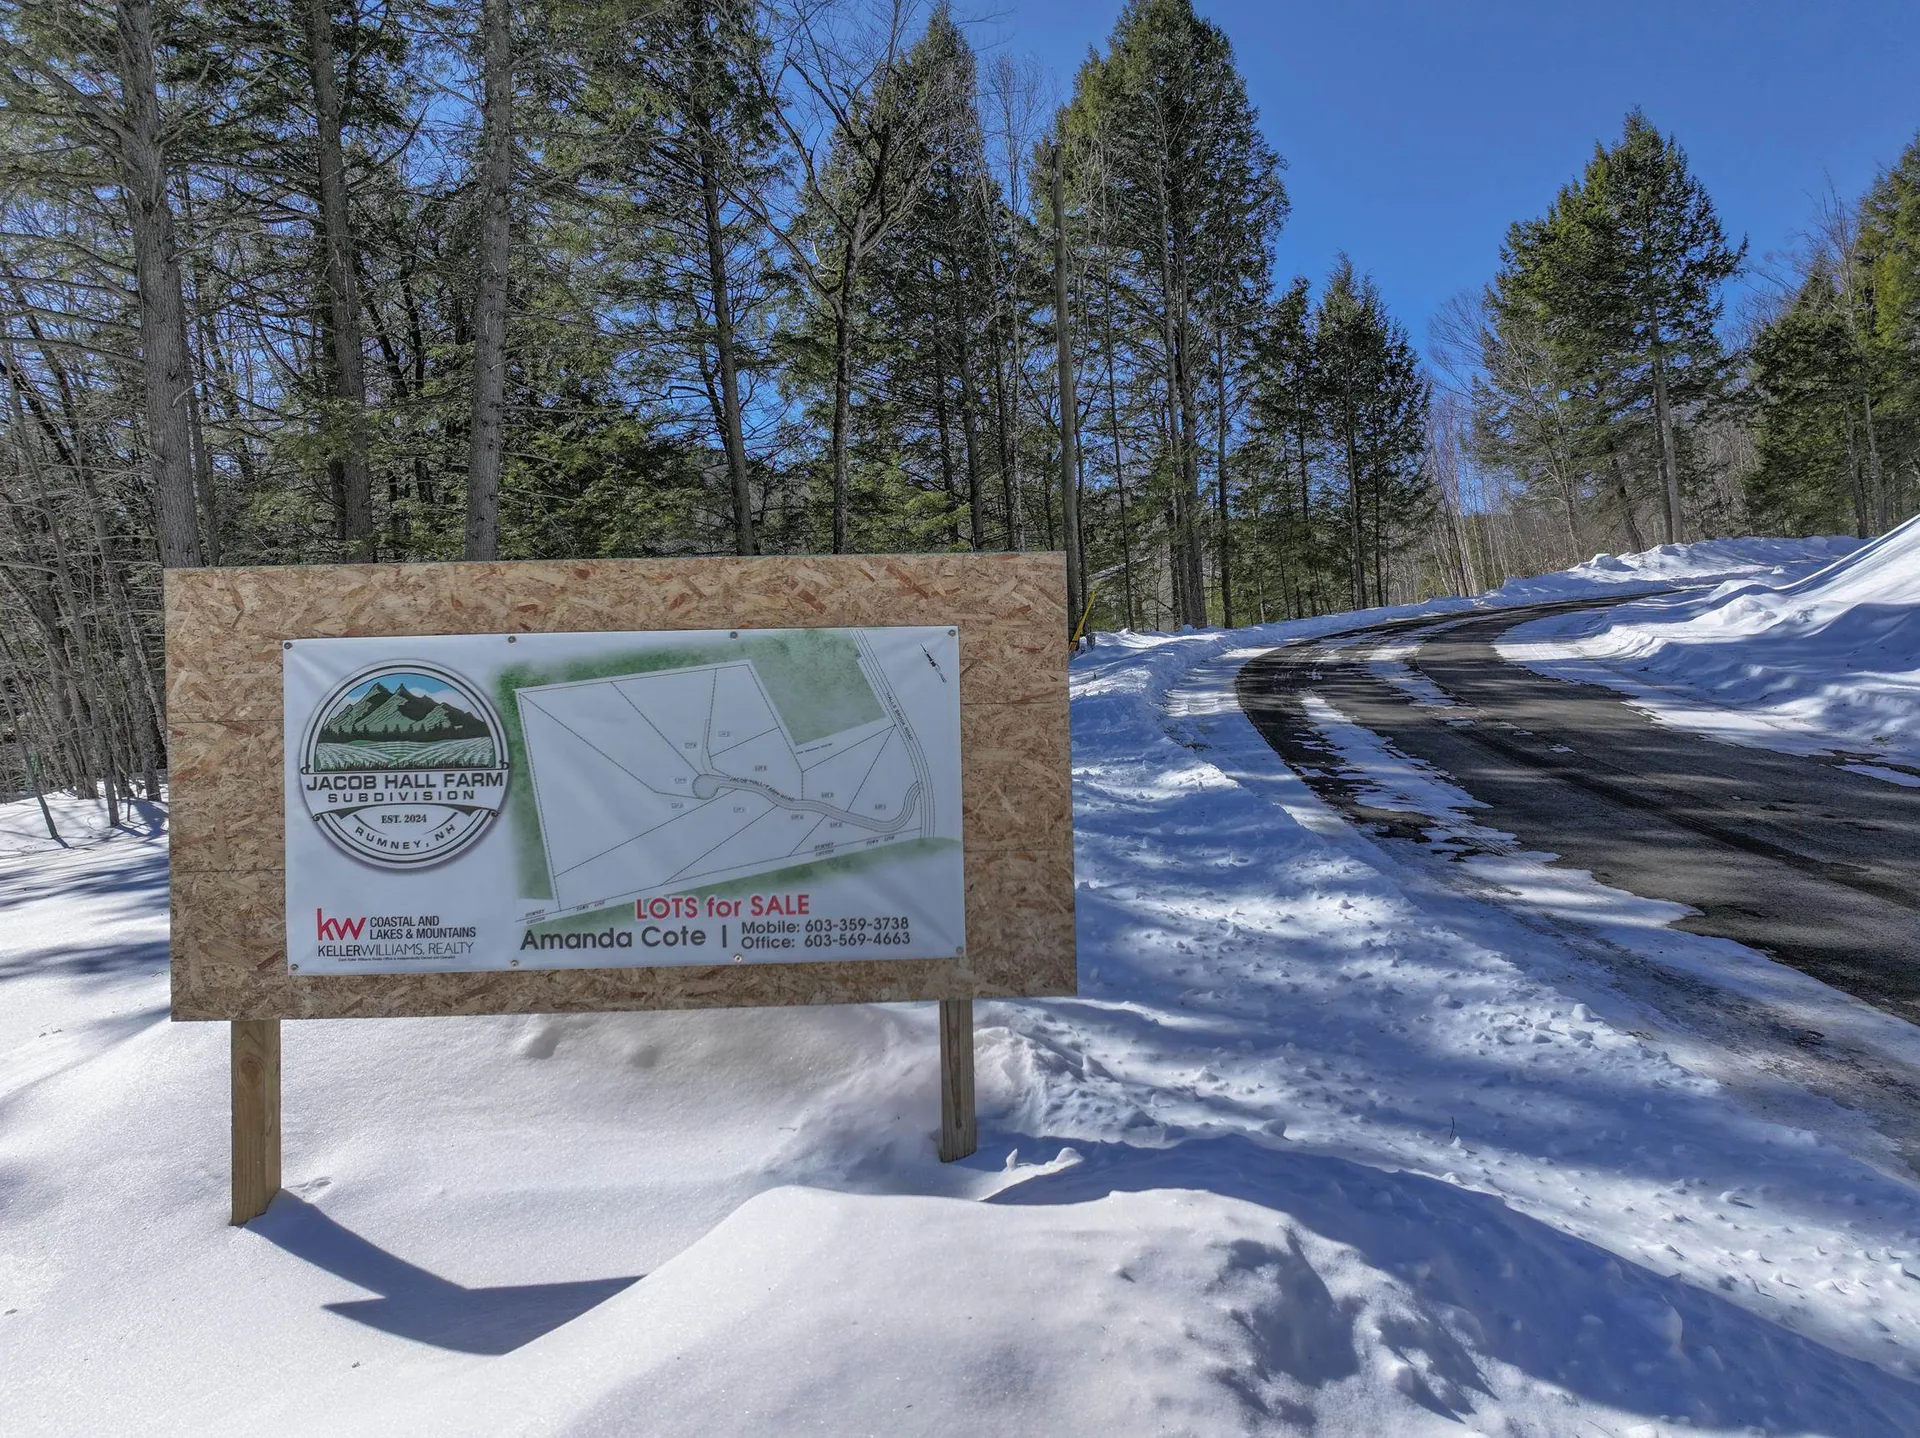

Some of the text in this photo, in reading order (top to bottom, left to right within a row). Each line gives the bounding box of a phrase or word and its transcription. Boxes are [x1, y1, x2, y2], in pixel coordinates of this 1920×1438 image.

[307, 772, 503, 791] JACOB HALL FARM
[328, 790, 475, 803] SUBDIVISION
[381, 814, 427, 824] EST. 2024
[355, 824, 456, 850] RUMNEY, NH
[636, 894, 810, 920] LOTS for SALE
[316, 908, 366, 941] kw
[370, 915, 440, 928] COASTAL AND
[741, 917, 909, 934] Mobile: 603-359-3738
[370, 926, 477, 940] LAKES & MOUNTAINS
[520, 925, 706, 950] Amanda Cote
[741, 932, 911, 950] Office: 603-569-4663
[428, 942, 475, 955] REALTY
